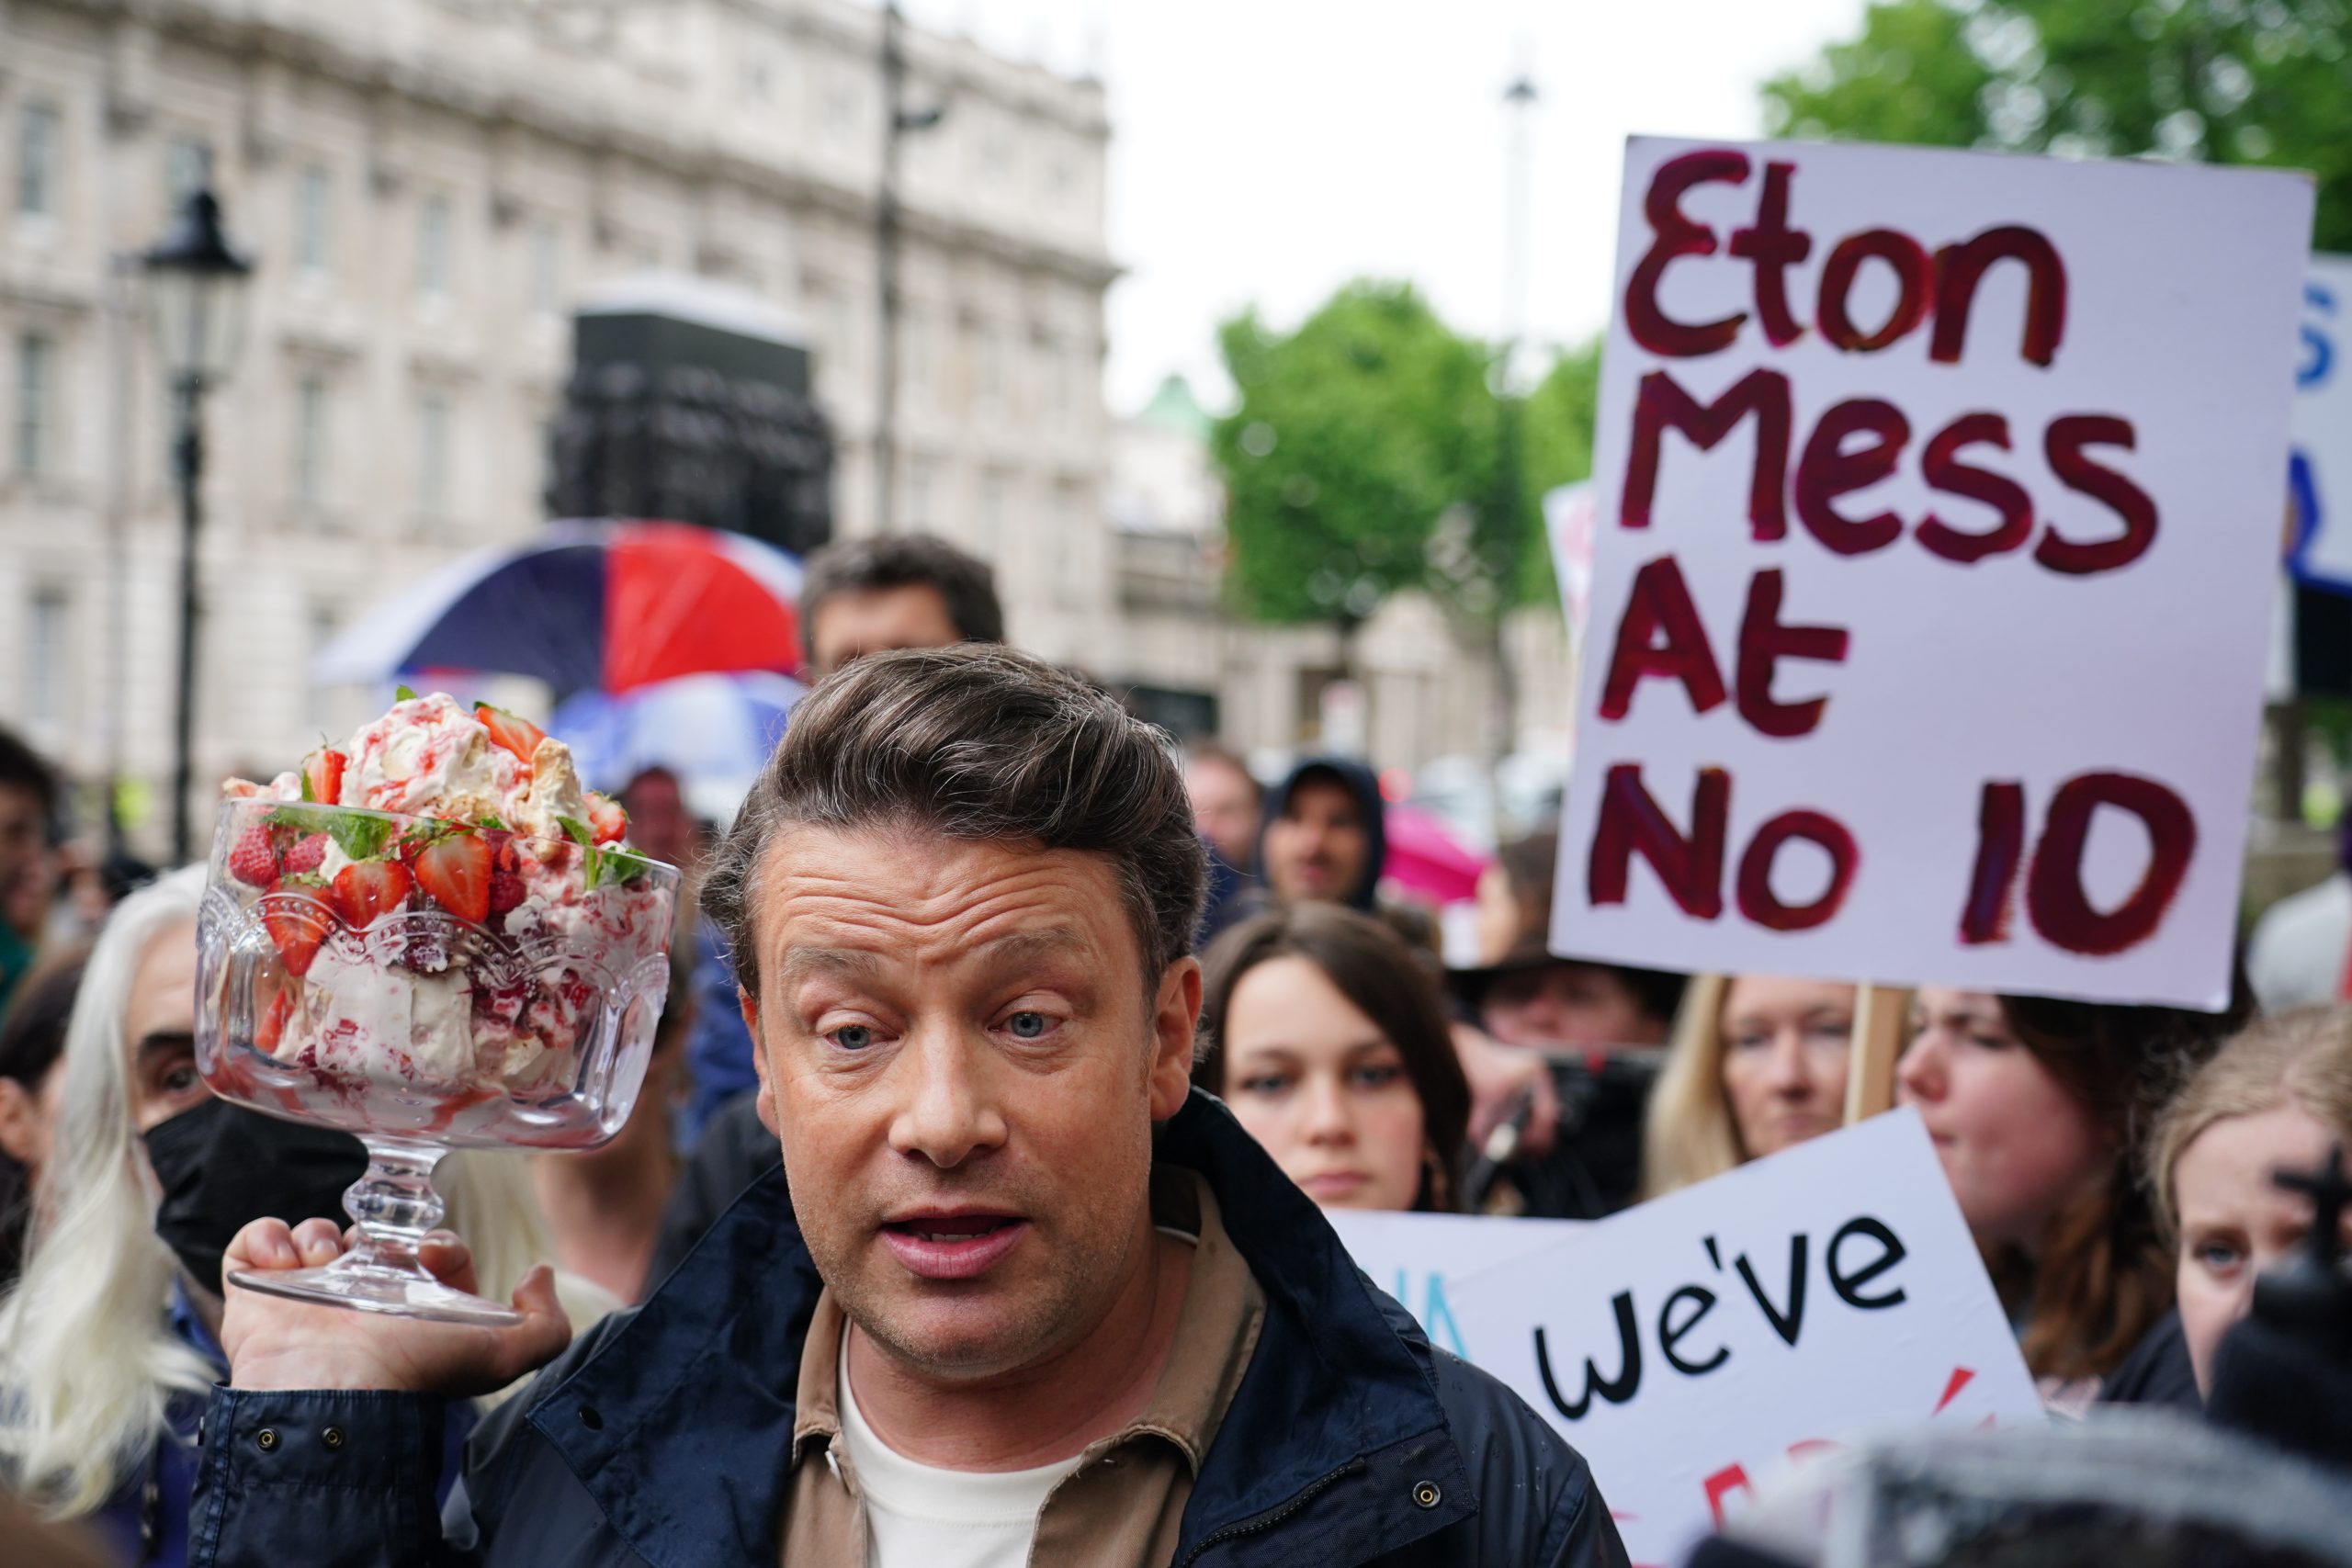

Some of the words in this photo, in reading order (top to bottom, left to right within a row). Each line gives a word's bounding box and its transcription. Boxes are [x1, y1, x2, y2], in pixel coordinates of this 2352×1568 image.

[1623, 148, 2069, 369] Eton
[1619, 367, 2160, 578] Mess
[1597, 554, 1850, 739] At
[1585, 761, 1861, 934] No
[1957, 769, 2200, 959] 10
